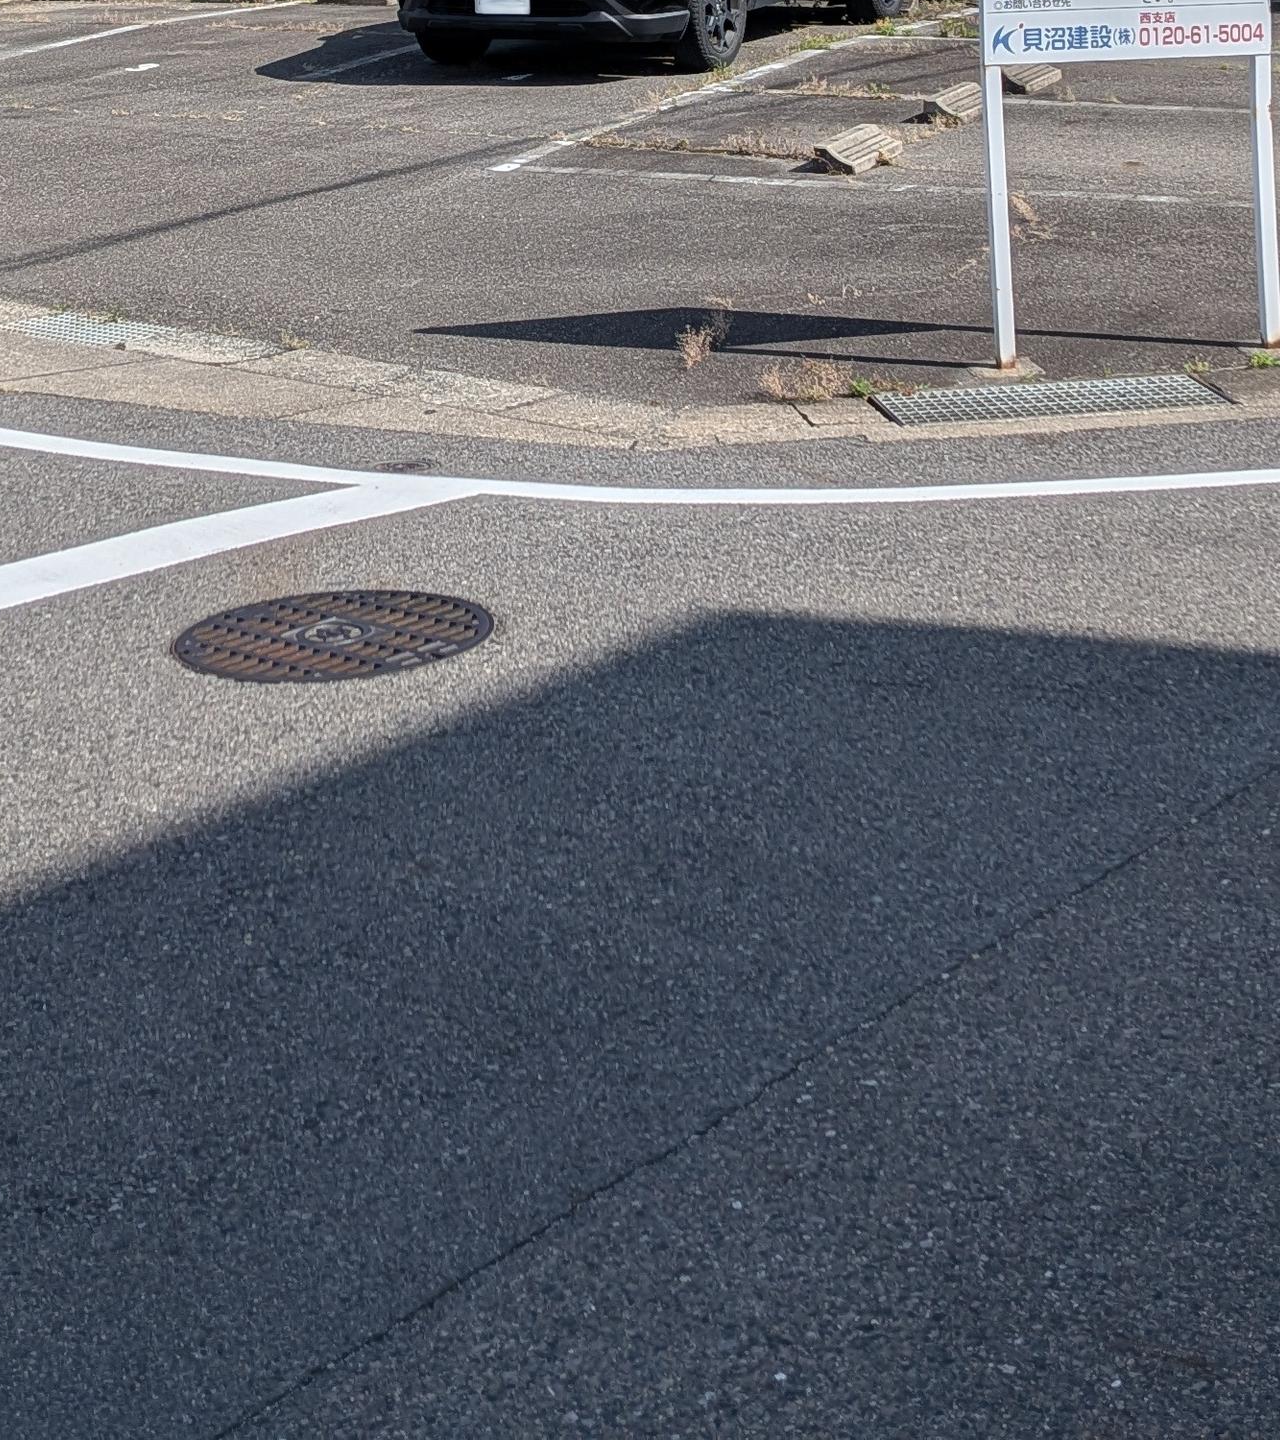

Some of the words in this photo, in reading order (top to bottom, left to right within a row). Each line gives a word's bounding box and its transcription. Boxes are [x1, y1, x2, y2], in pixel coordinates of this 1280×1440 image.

[1139, 12, 1176, 24] 西支店
[1139, 23, 1265, 47] 0120-61-5004
